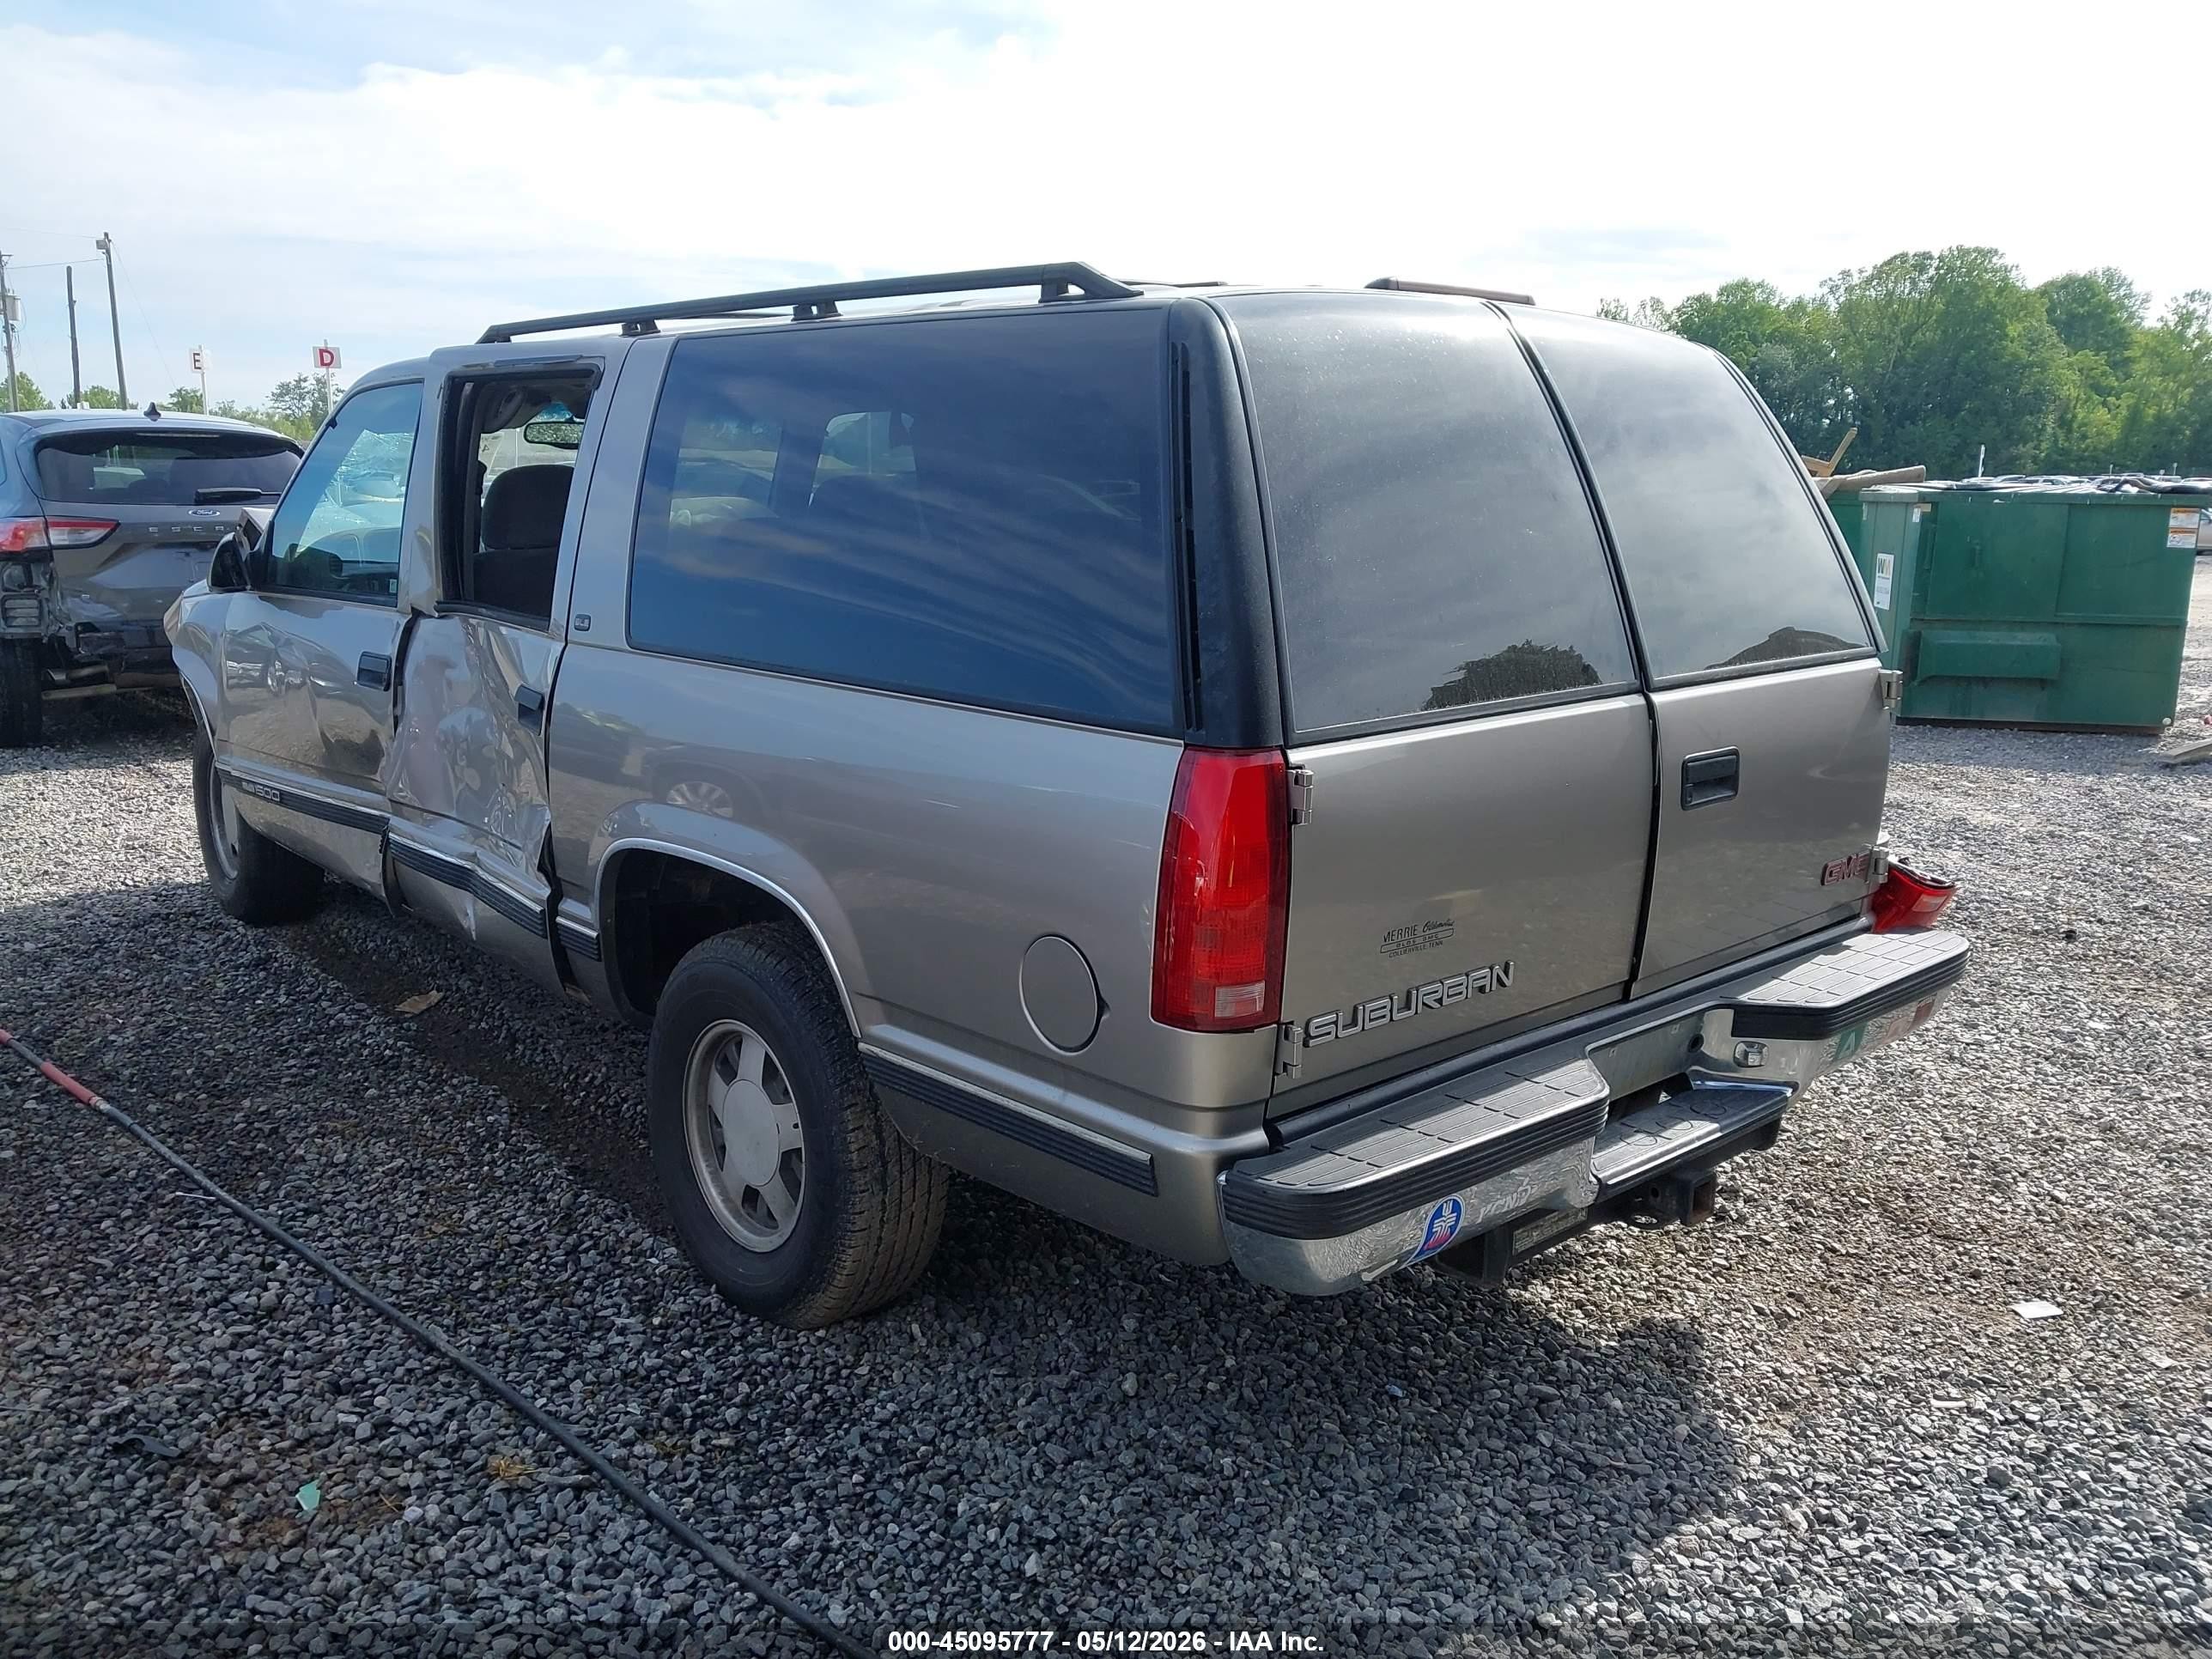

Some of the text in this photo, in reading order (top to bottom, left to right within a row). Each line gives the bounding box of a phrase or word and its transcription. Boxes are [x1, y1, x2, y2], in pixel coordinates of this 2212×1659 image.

[191, 352, 203, 370] E
[318, 348, 335, 368] D
[1303, 960, 1515, 1048] SUBURBAN
